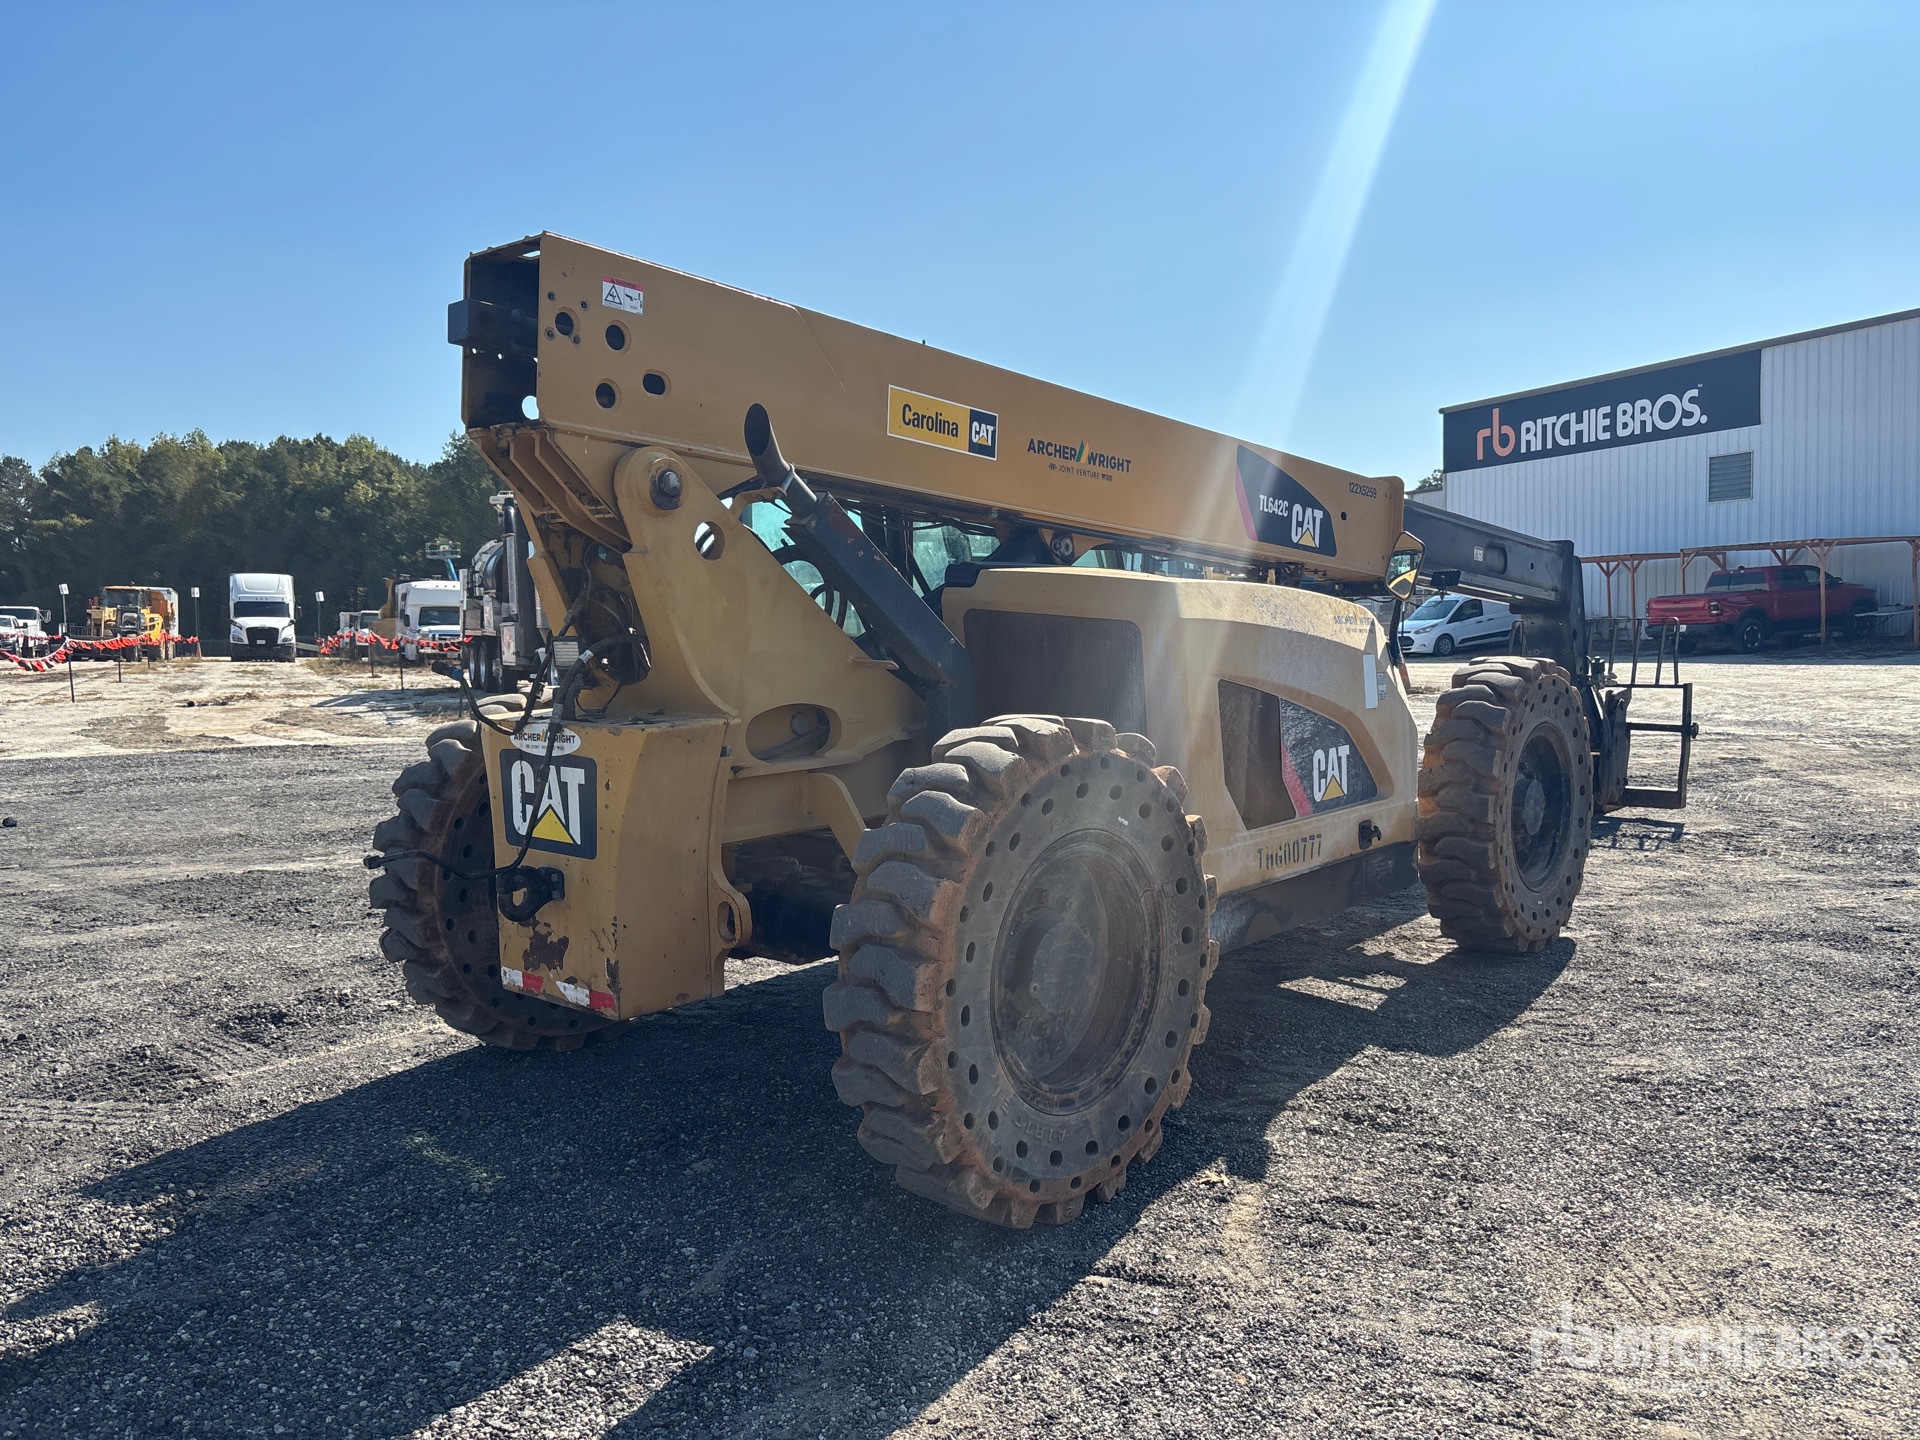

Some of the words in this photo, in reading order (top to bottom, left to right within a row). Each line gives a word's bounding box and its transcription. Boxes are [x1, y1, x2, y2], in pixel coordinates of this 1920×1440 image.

[902, 403, 959, 438] Carolina
[971, 421, 994, 447] CAT
[1476, 407, 1516, 460] rb
[1520, 405, 1611, 453] RITCHIE
[1616, 388, 1708, 438] BROS.
[1027, 438, 1077, 462] ARCHER
[1087, 451, 1132, 474] WRIGHT
[1058, 464, 1075, 474] JOINT
[1076, 468, 1100, 480] VENTURE
[1259, 494, 1289, 518] TL642C
[1290, 503, 1324, 549] CAT
[514, 732, 541, 742] ARCHER
[554, 734, 576, 745] RIGHT
[1312, 744, 1350, 802] CAT
[511, 760, 585, 845] CAT
